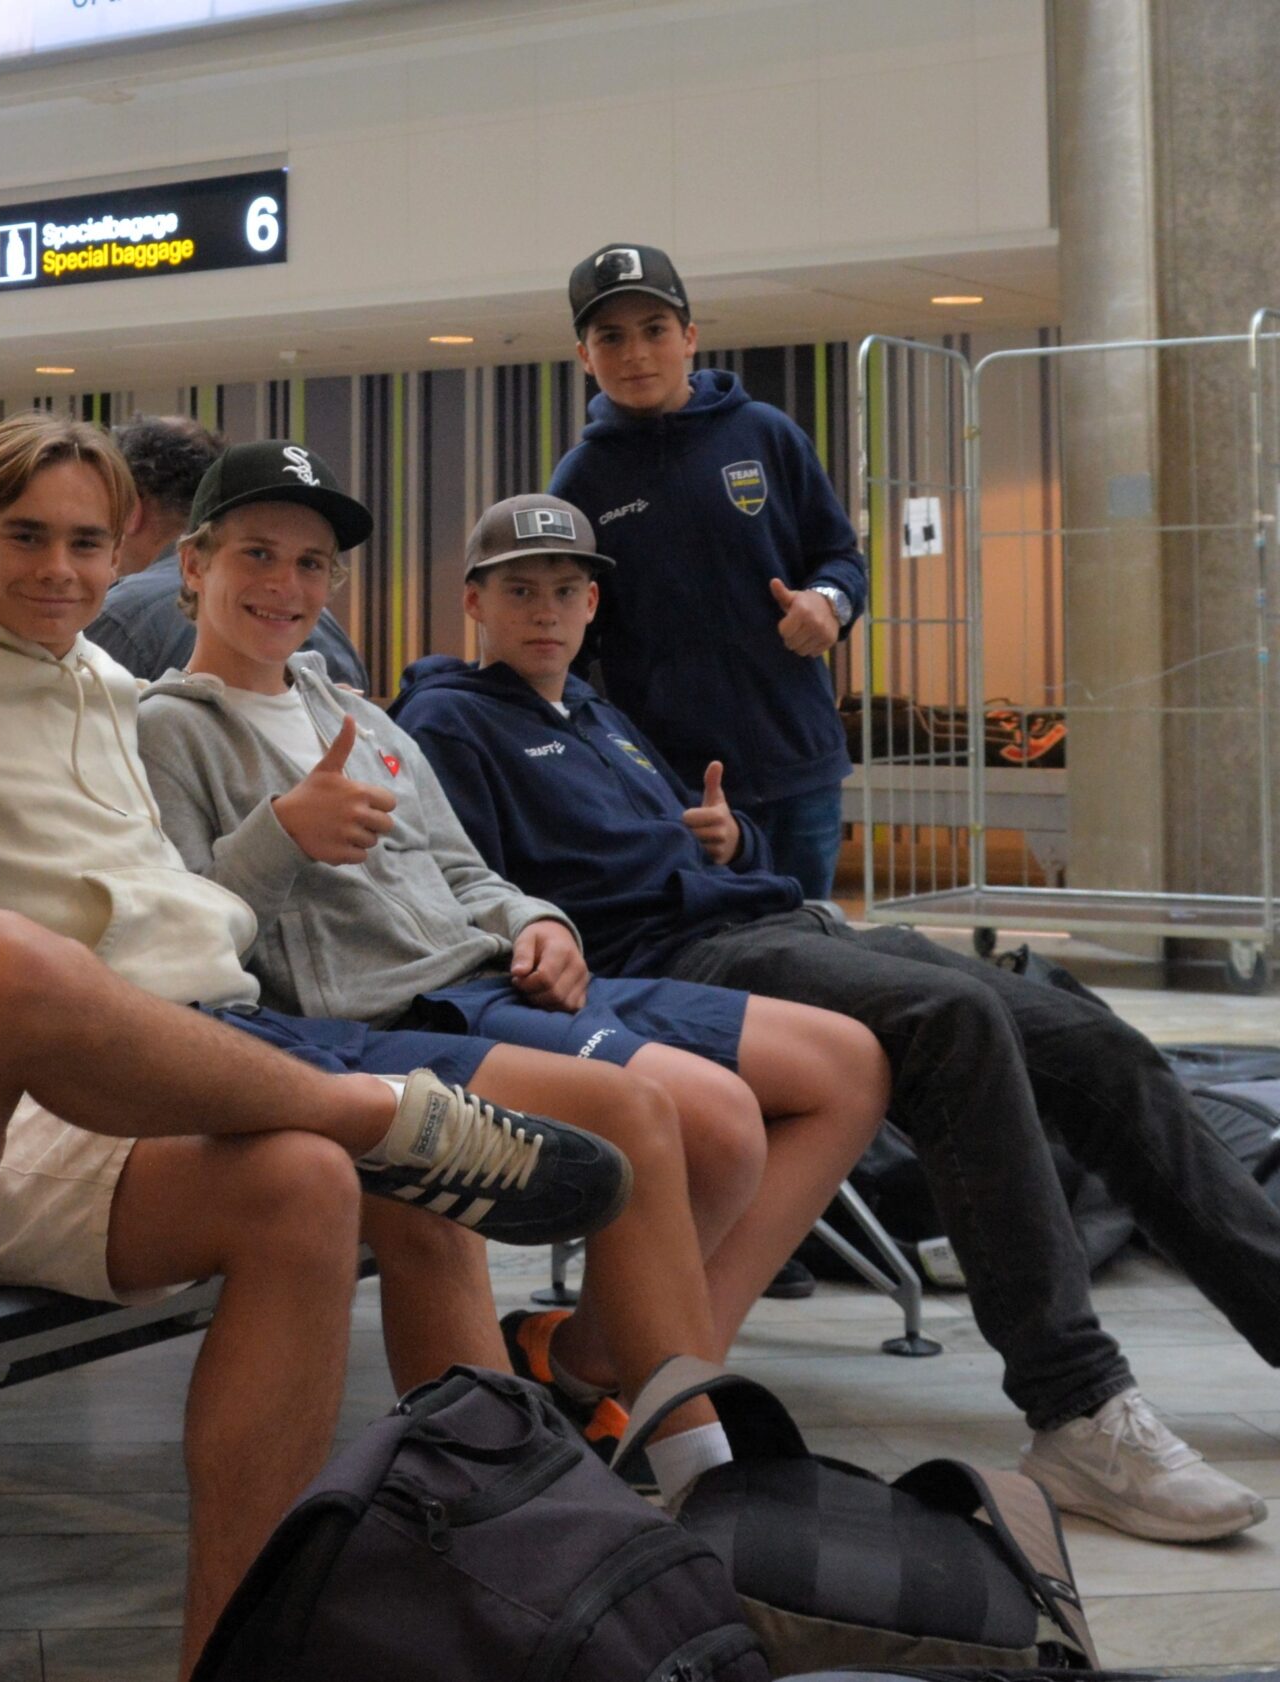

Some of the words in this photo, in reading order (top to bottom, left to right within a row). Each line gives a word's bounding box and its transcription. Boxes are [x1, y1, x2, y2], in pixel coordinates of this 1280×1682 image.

[42, 213, 178, 250] Specialbagage
[245, 196, 279, 252] 6
[43, 243, 108, 276] Special
[111, 239, 194, 269] baggage
[728, 468, 759, 481] TEAM
[534, 510, 554, 534] P
[599, 501, 636, 525] CRAFT
[577, 1028, 609, 1059] RAFT
